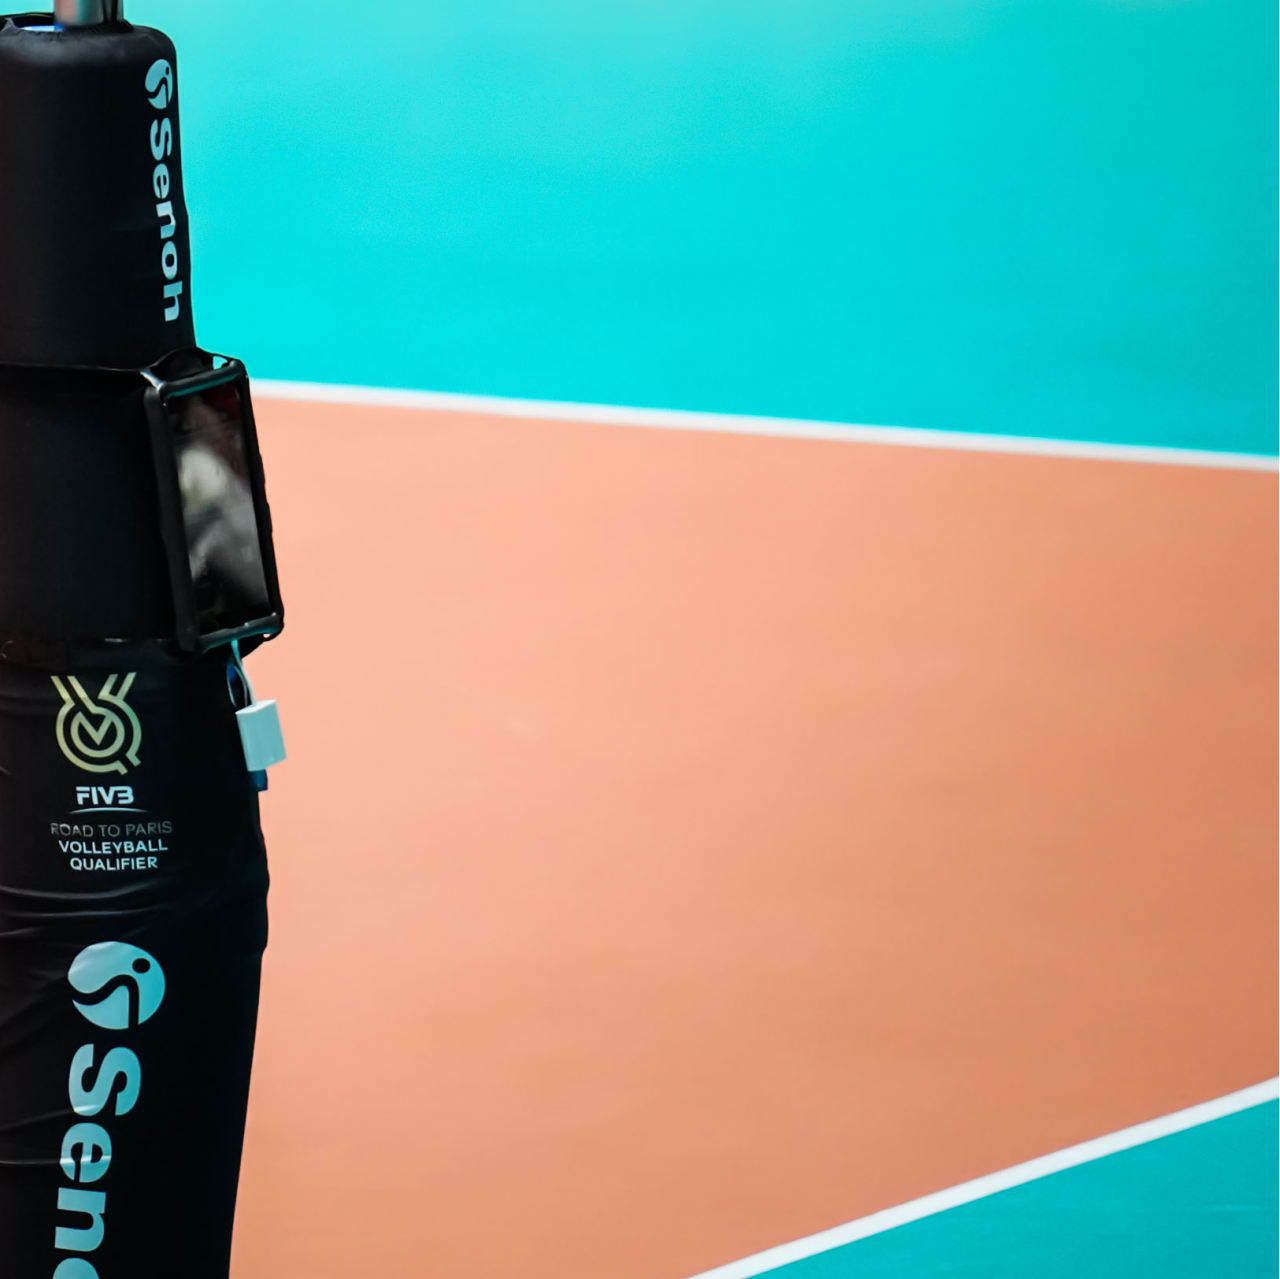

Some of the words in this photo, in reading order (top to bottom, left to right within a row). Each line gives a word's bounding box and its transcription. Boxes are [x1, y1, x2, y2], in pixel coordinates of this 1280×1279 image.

[150, 117, 183, 322] Senoh
[76, 785, 134, 805] FIVB
[50, 822, 94, 837] ROAD
[99, 824, 121, 837] TO
[125, 820, 173, 837] PARIS
[58, 838, 169, 855] VOLLEYBALL
[69, 856, 159, 871] QUALIFIER
